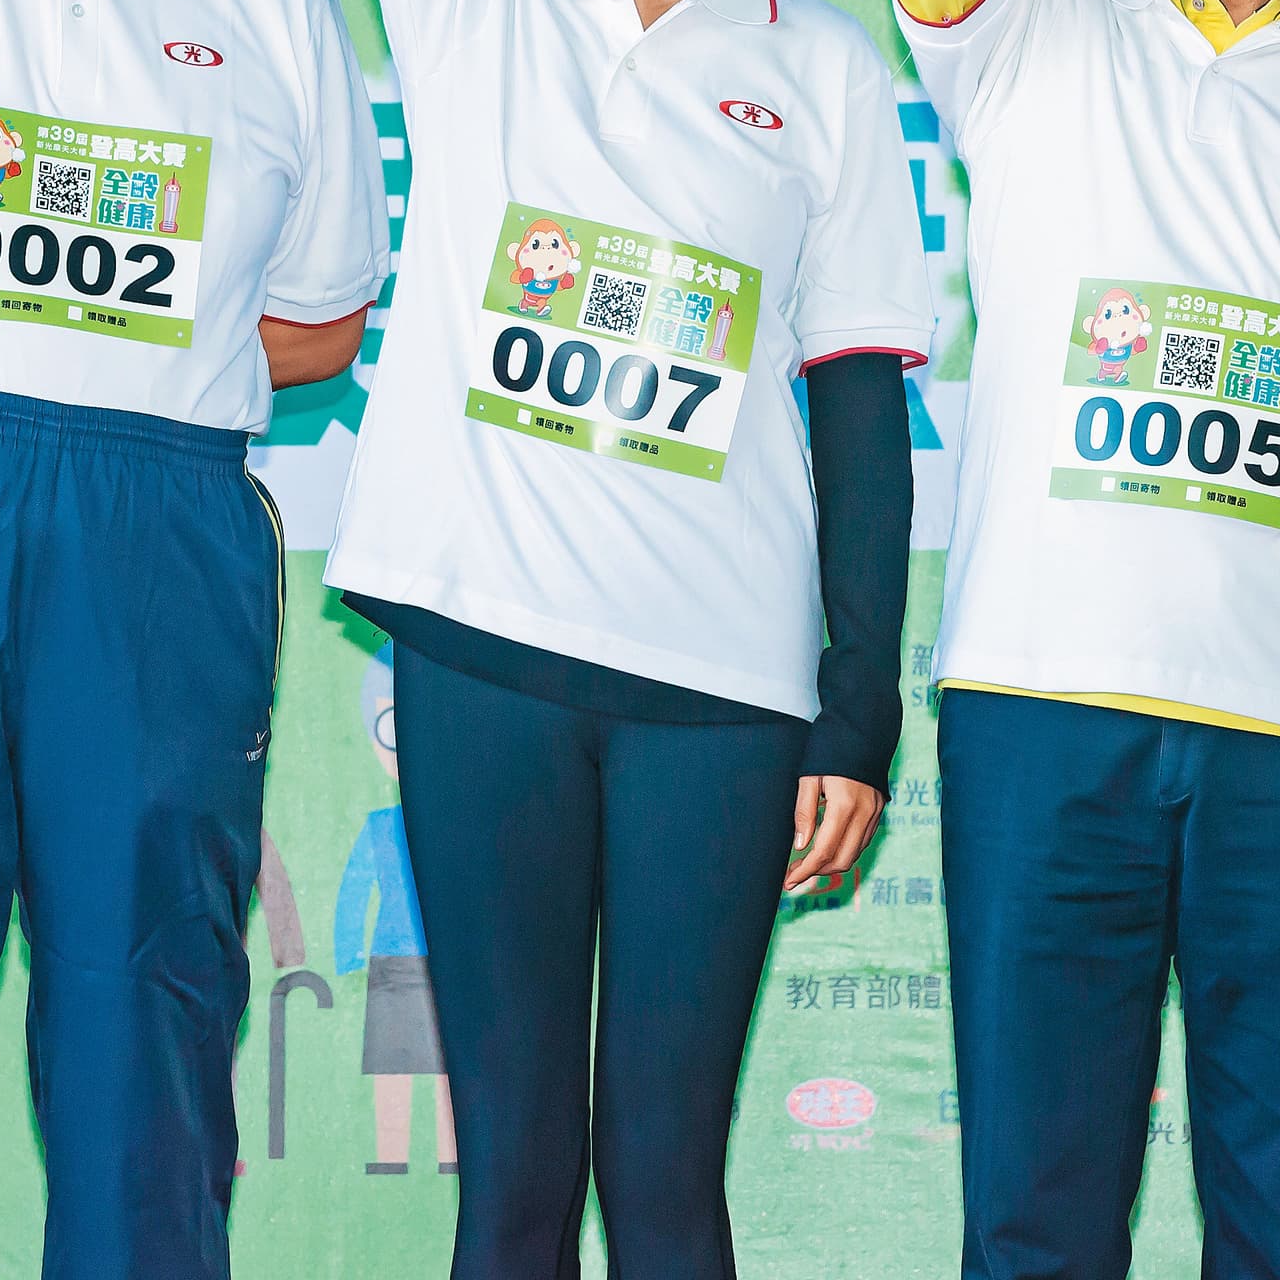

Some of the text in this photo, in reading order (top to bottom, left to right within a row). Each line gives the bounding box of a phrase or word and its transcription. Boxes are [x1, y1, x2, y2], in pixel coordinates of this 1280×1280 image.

[89, 134, 187, 168] 登高大賽
[102, 167, 159, 201] 全齡
[96, 196, 157, 231] 健康
[655, 285, 713, 324] 全齡
[492, 326, 722, 433] 0007
[786, 974, 942, 1009] 教育部體
